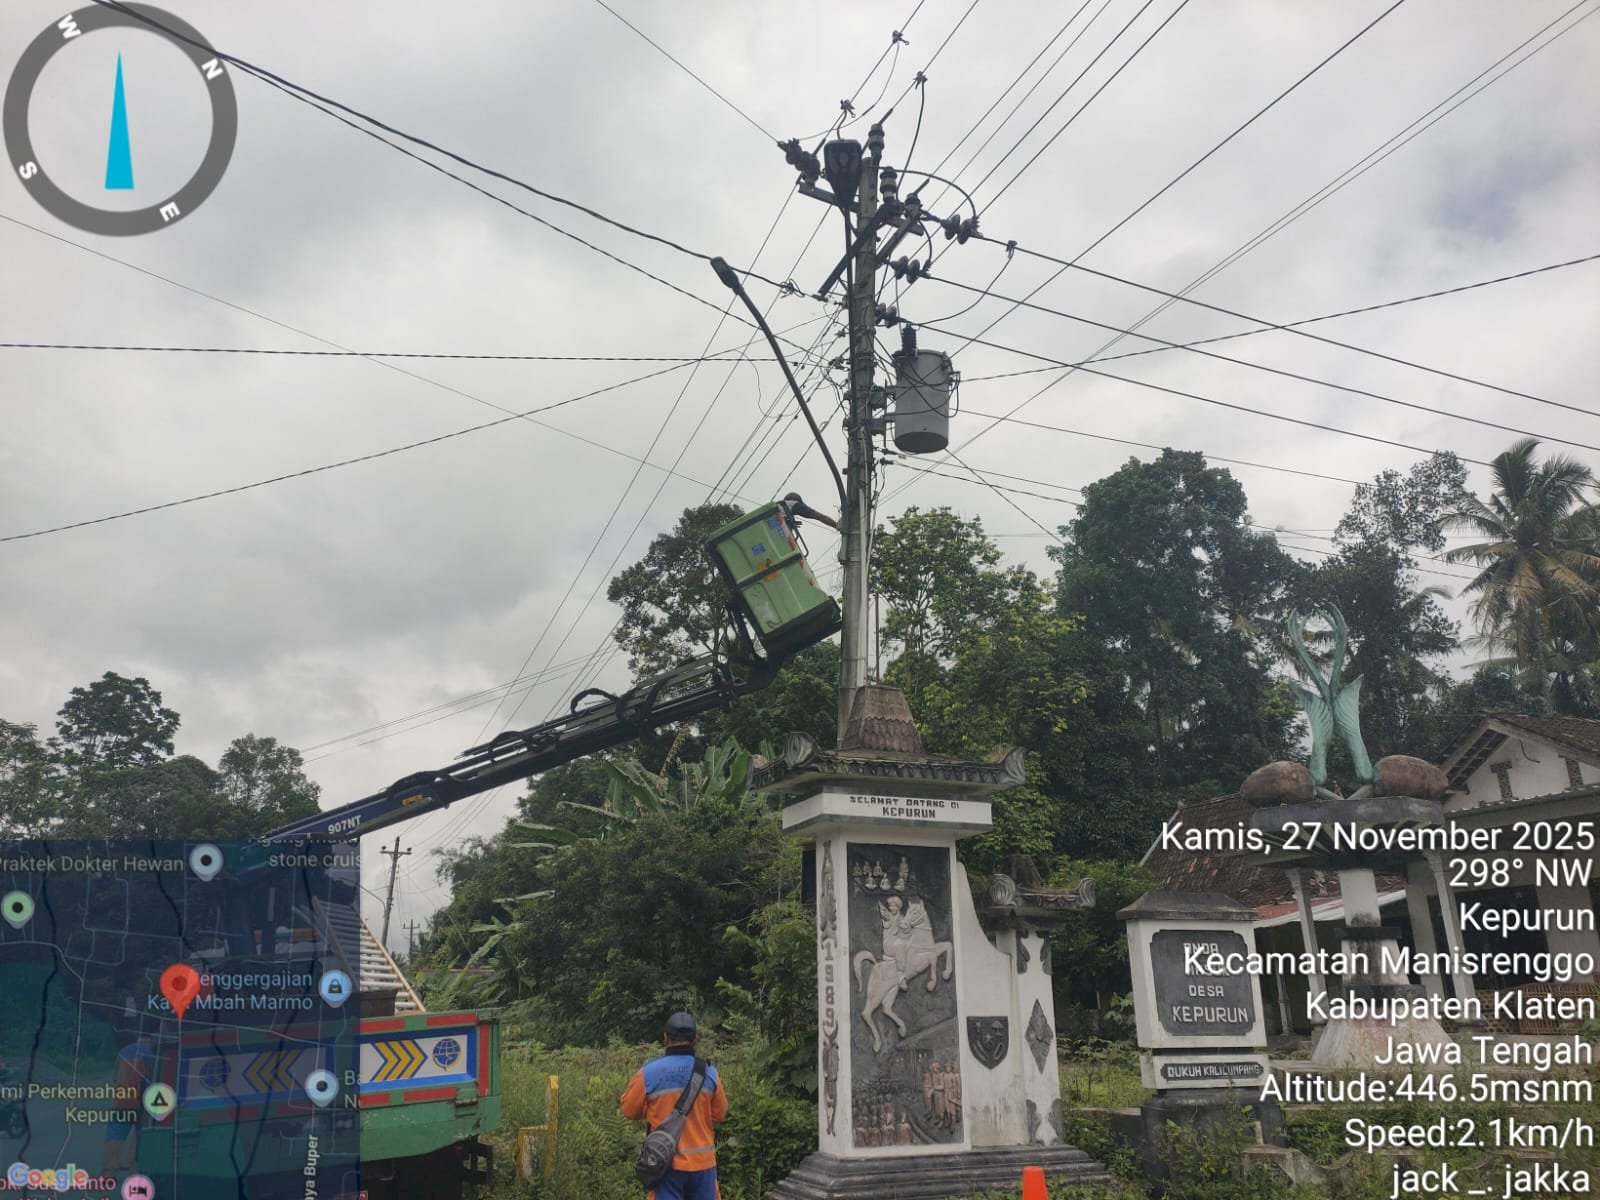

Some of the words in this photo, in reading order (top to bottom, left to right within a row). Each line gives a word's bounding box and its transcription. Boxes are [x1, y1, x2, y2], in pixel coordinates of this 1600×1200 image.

[849, 795, 899, 805] SELAMAT
[906, 799, 945, 808] DATANG
[950, 801, 959, 809] DI
[882, 806, 936, 819] KEPURUN
[328, 814, 362, 835] 907NT
[1189, 984, 1225, 997] DESA
[1172, 1005, 1249, 1023] KEPURUN
[1167, 1065, 1201, 1078] DUKUH
